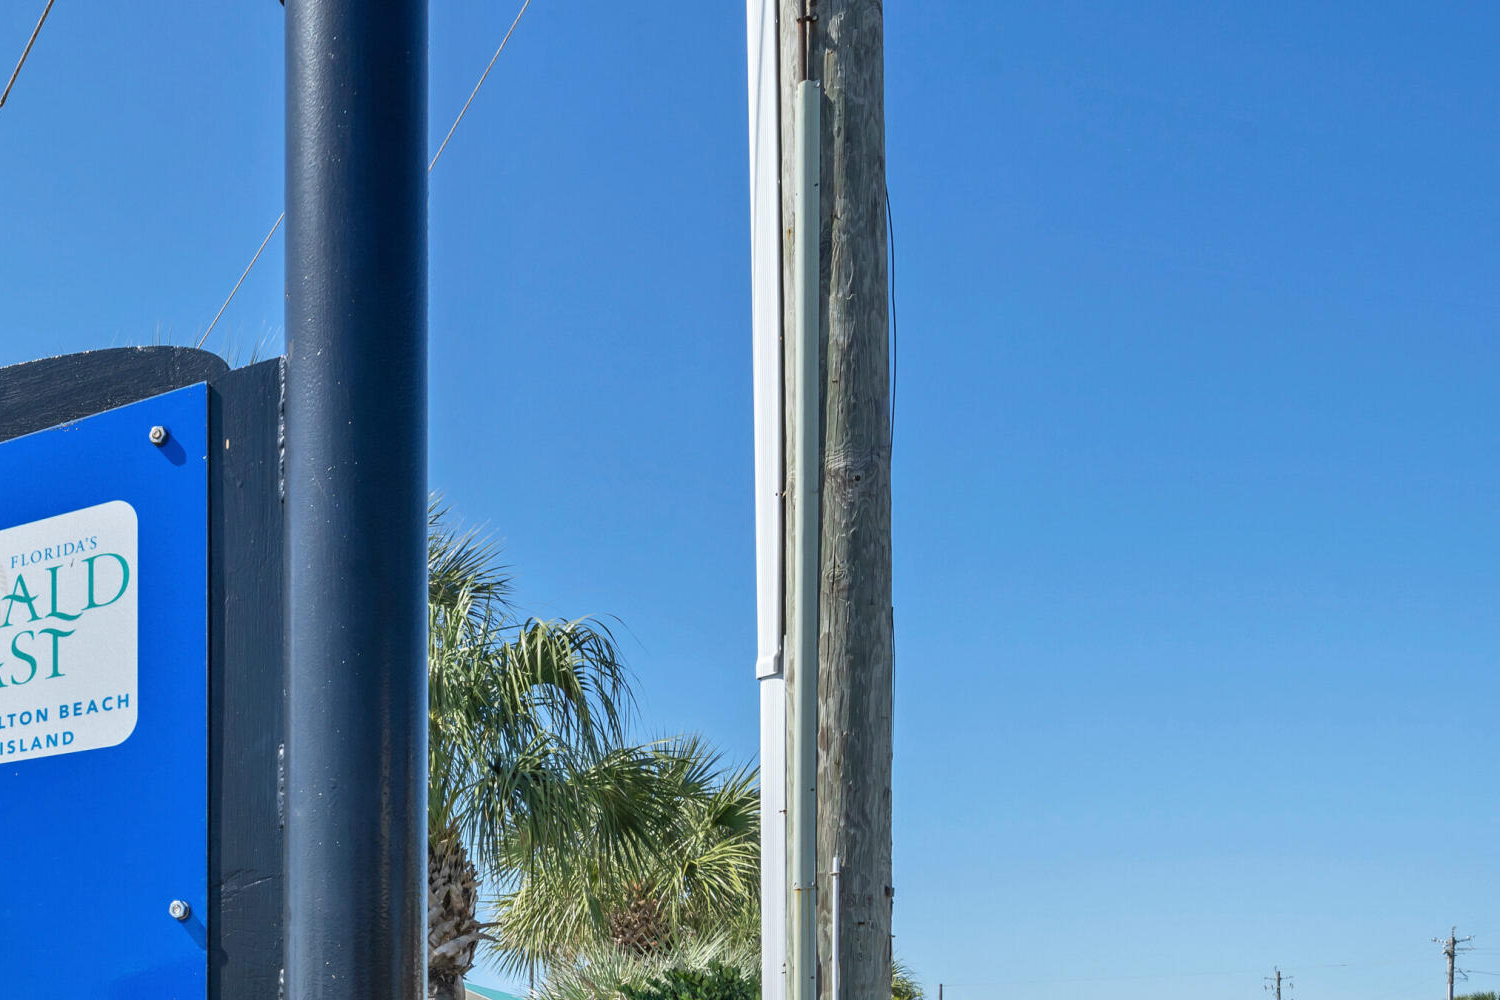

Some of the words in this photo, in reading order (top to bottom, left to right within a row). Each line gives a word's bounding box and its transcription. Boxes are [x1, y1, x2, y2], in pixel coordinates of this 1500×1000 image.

[10, 535, 98, 570] FLORIDA'S
[59, 693, 131, 720] BEACH
[0, 730, 75, 757] ISLAND
